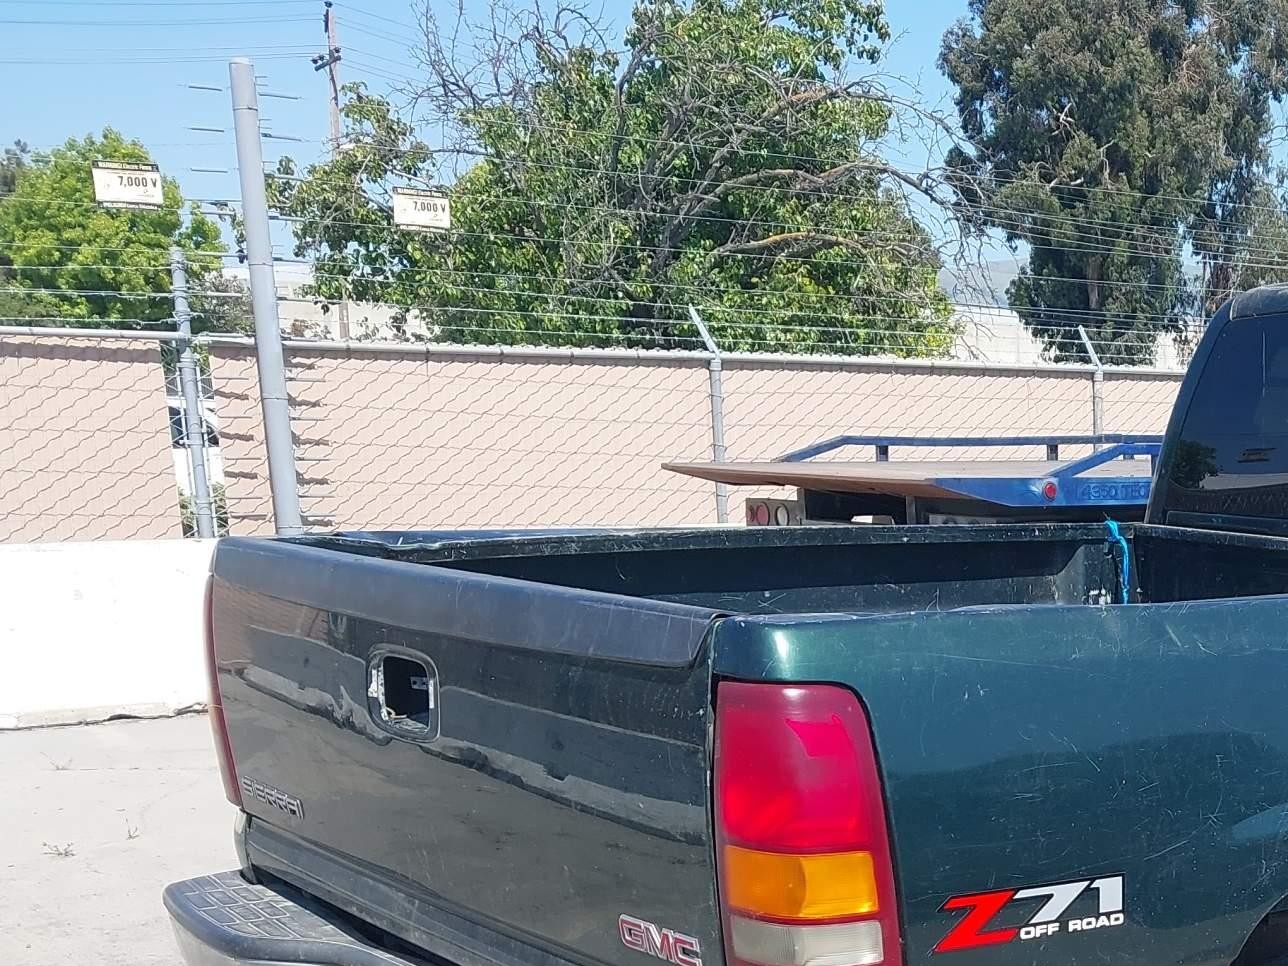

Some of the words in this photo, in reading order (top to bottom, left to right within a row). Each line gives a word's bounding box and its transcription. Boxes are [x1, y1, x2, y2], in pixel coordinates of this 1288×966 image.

[117, 175, 148, 188] 7,000
[150, 177, 158, 188] V
[413, 200, 438, 213] 7,000
[440, 203, 446, 213] V
[241, 776, 305, 820] SIERRA
[933, 875, 1123, 954] Z71
[1019, 922, 1060, 940] OFF
[1068, 913, 1125, 933] ROAD
